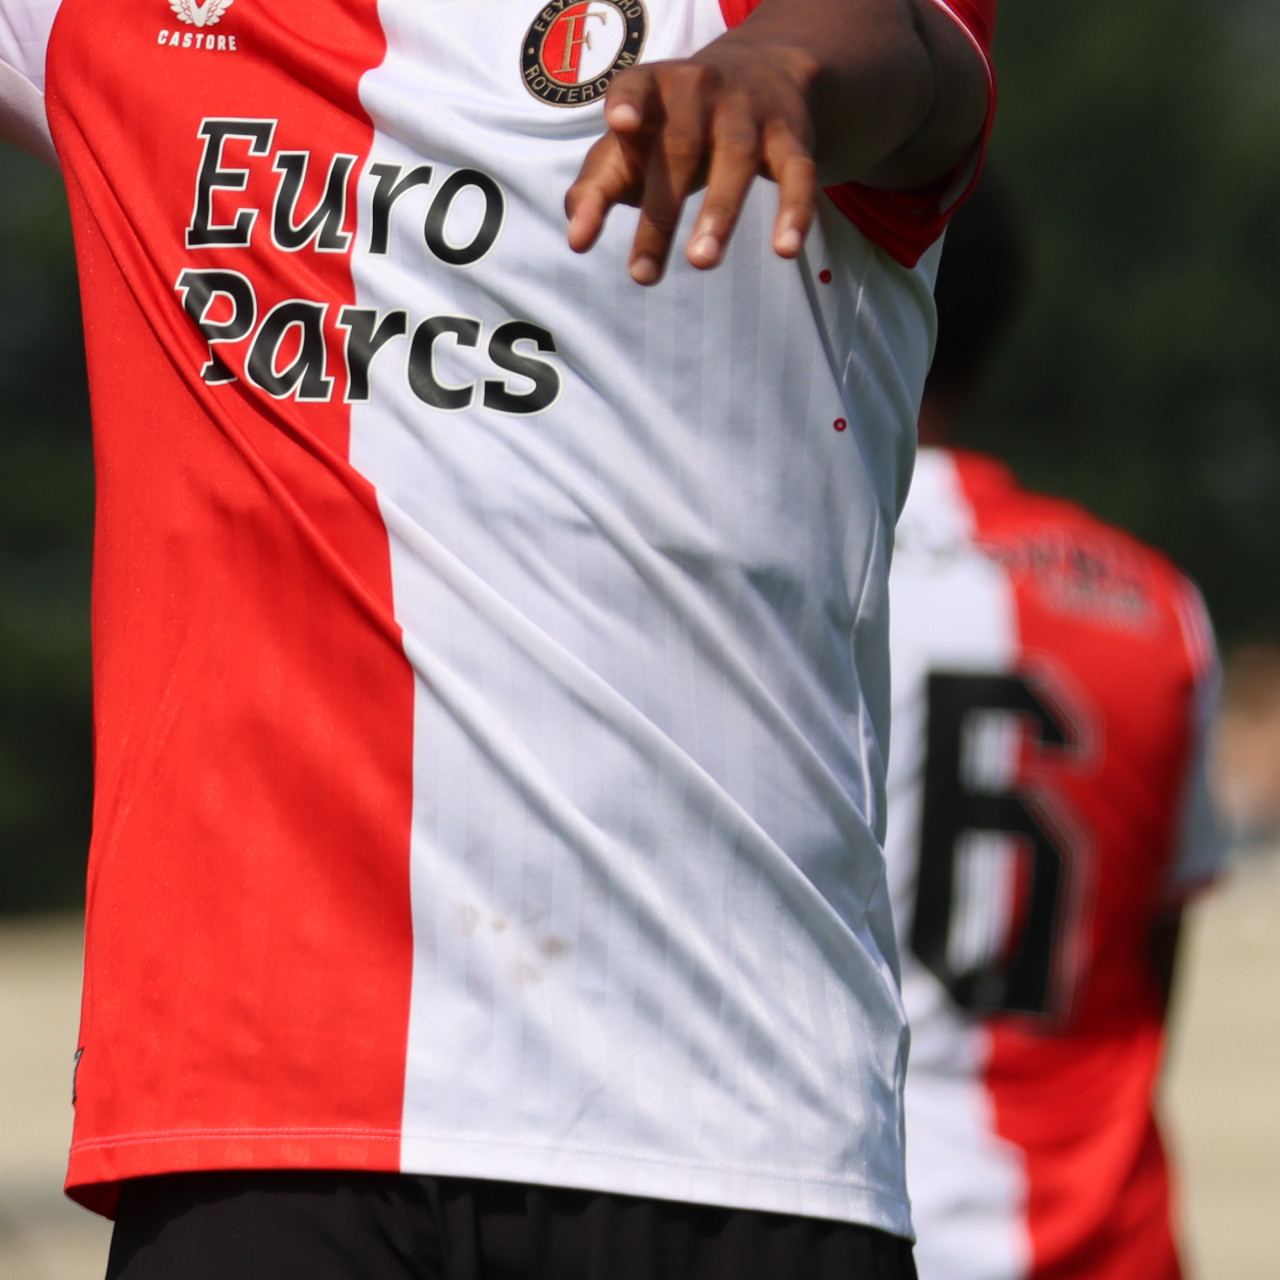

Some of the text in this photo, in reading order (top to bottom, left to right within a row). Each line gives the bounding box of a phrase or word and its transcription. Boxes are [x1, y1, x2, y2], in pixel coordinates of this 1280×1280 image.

[157, 29, 237, 51] CASTORE
[184, 117, 507, 267] Euro
[174, 267, 564, 415] Parcs
[910, 662, 1105, 1032] 6
